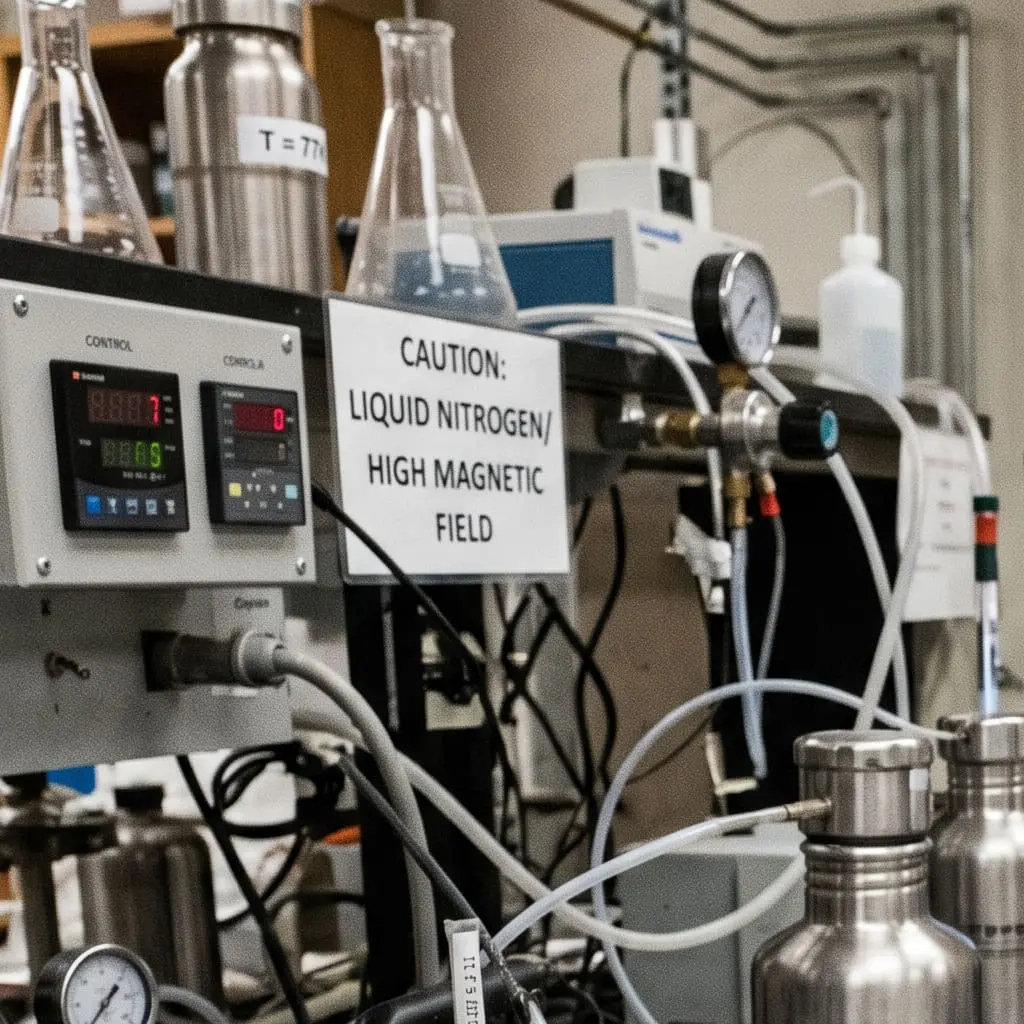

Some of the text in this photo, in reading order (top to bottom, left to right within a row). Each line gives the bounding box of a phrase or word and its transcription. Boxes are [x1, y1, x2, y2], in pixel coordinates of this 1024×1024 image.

[258, 127, 274, 152] T
[401, 336, 507, 381] CAUTION:
[348, 388, 553, 446] LIQUID NITROGEN/
[367, 453, 545, 495] HIGH MAGNETIC
[435, 512, 494, 543] FIELD
